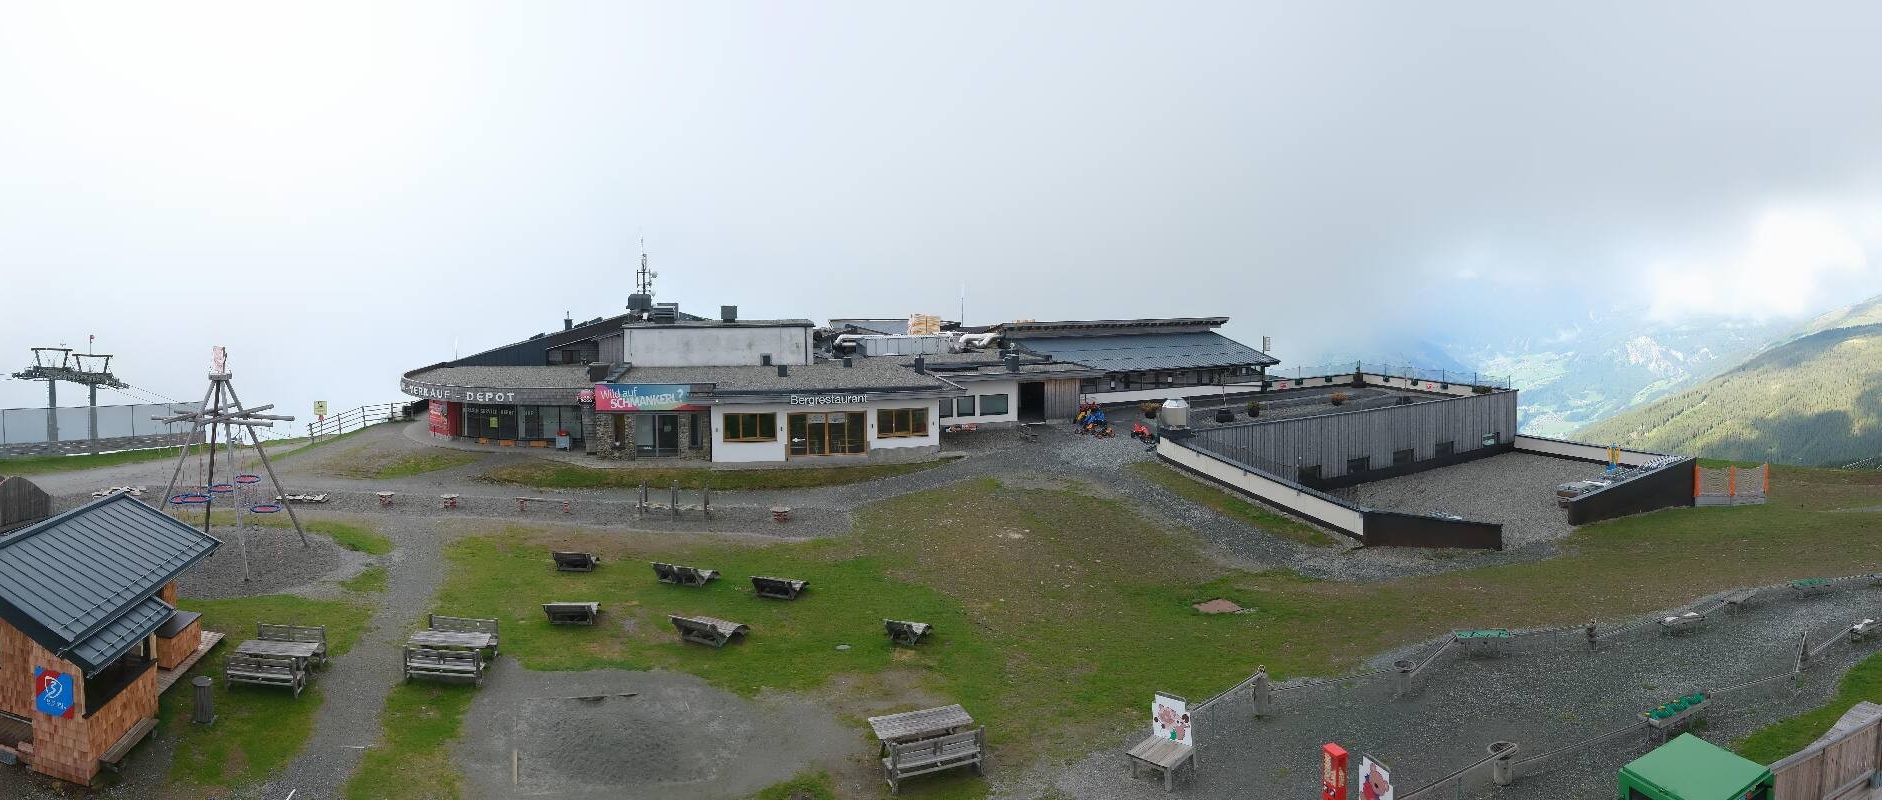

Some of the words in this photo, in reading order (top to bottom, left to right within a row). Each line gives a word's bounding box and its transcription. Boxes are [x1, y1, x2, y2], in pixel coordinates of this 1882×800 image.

[409, 385, 450, 399] VERKAUF
[466, 391, 515, 402] DEPOT
[600, 388, 620, 400] Wild
[622, 386, 637, 397] auf
[610, 389, 684, 409] SCHMANKERL?
[790, 393, 868, 406] Bergrestaurant
